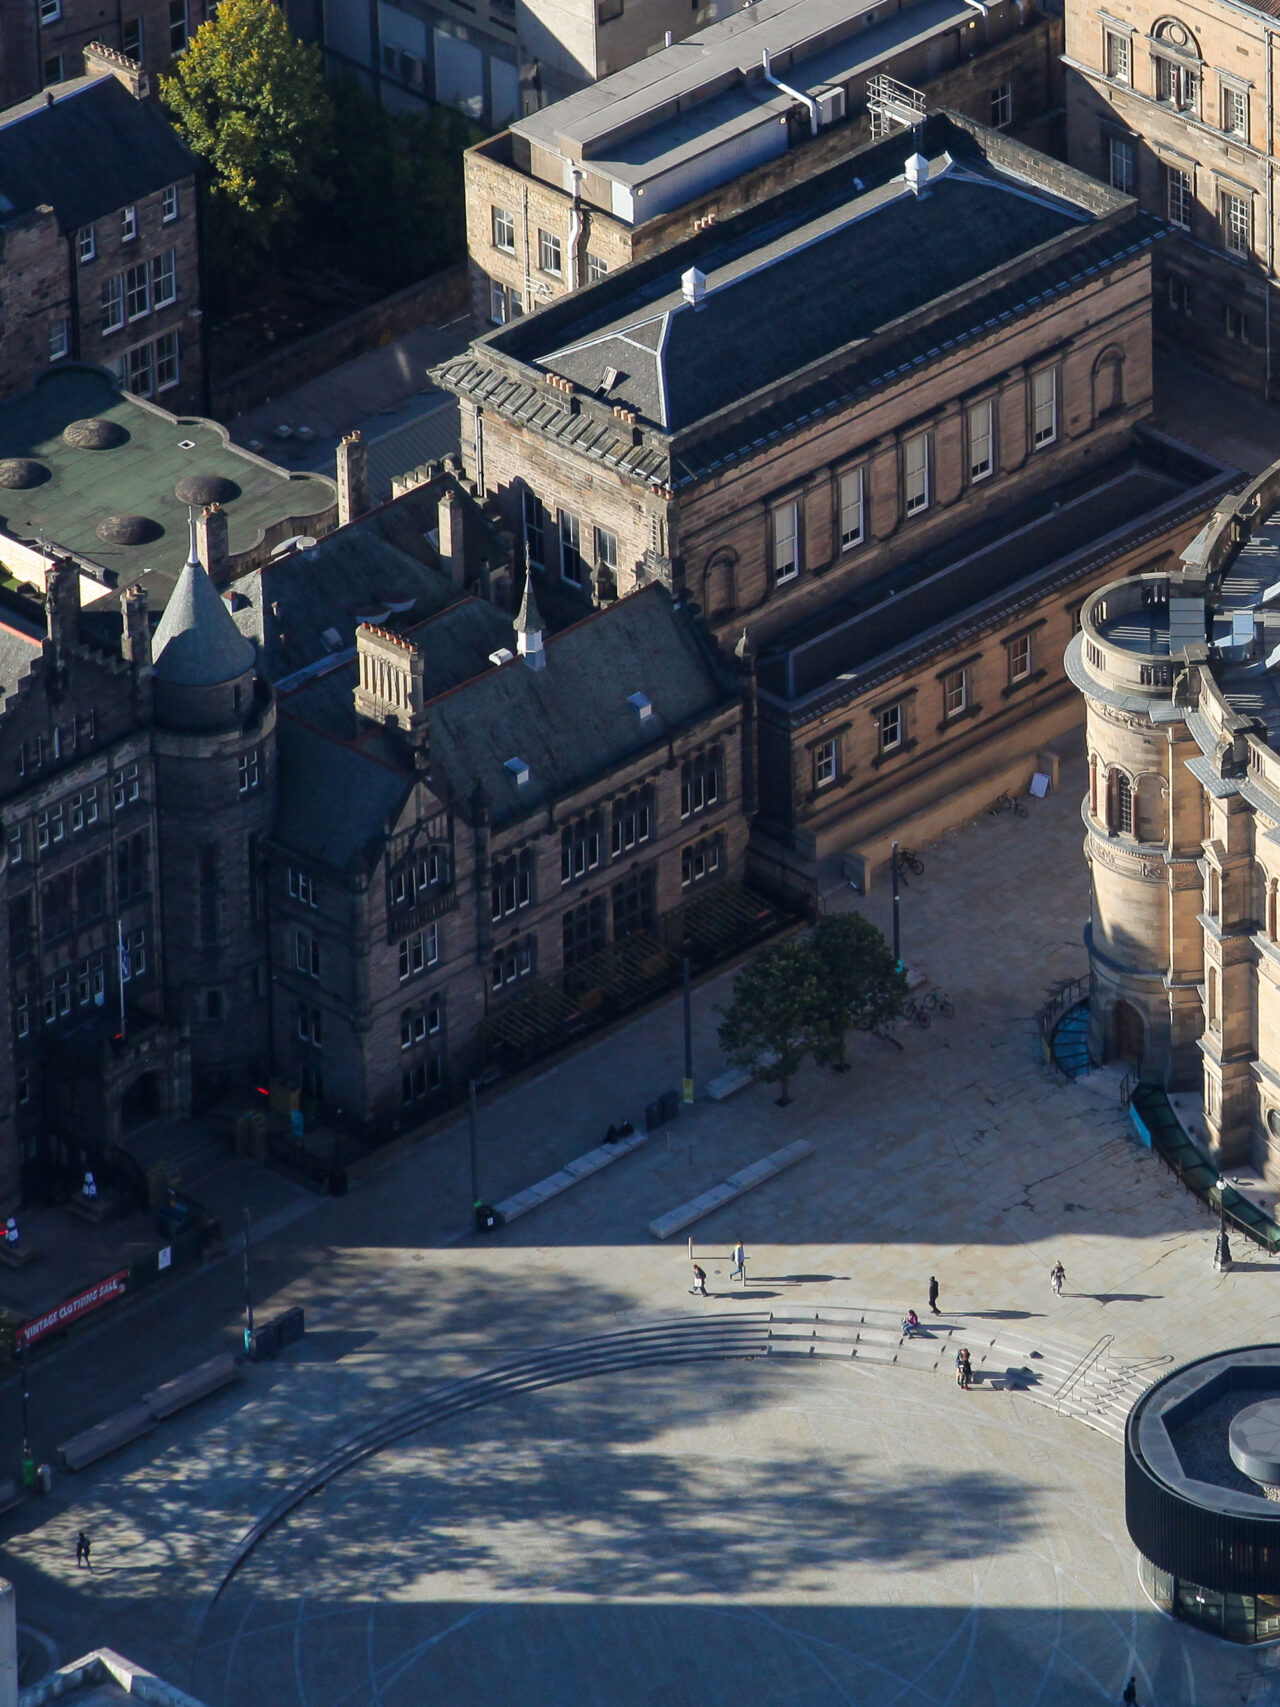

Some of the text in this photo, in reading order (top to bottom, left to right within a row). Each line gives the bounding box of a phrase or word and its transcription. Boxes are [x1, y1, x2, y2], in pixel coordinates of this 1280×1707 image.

[24, 1279, 118, 1339] VINTAGE CLOTHING SALE
